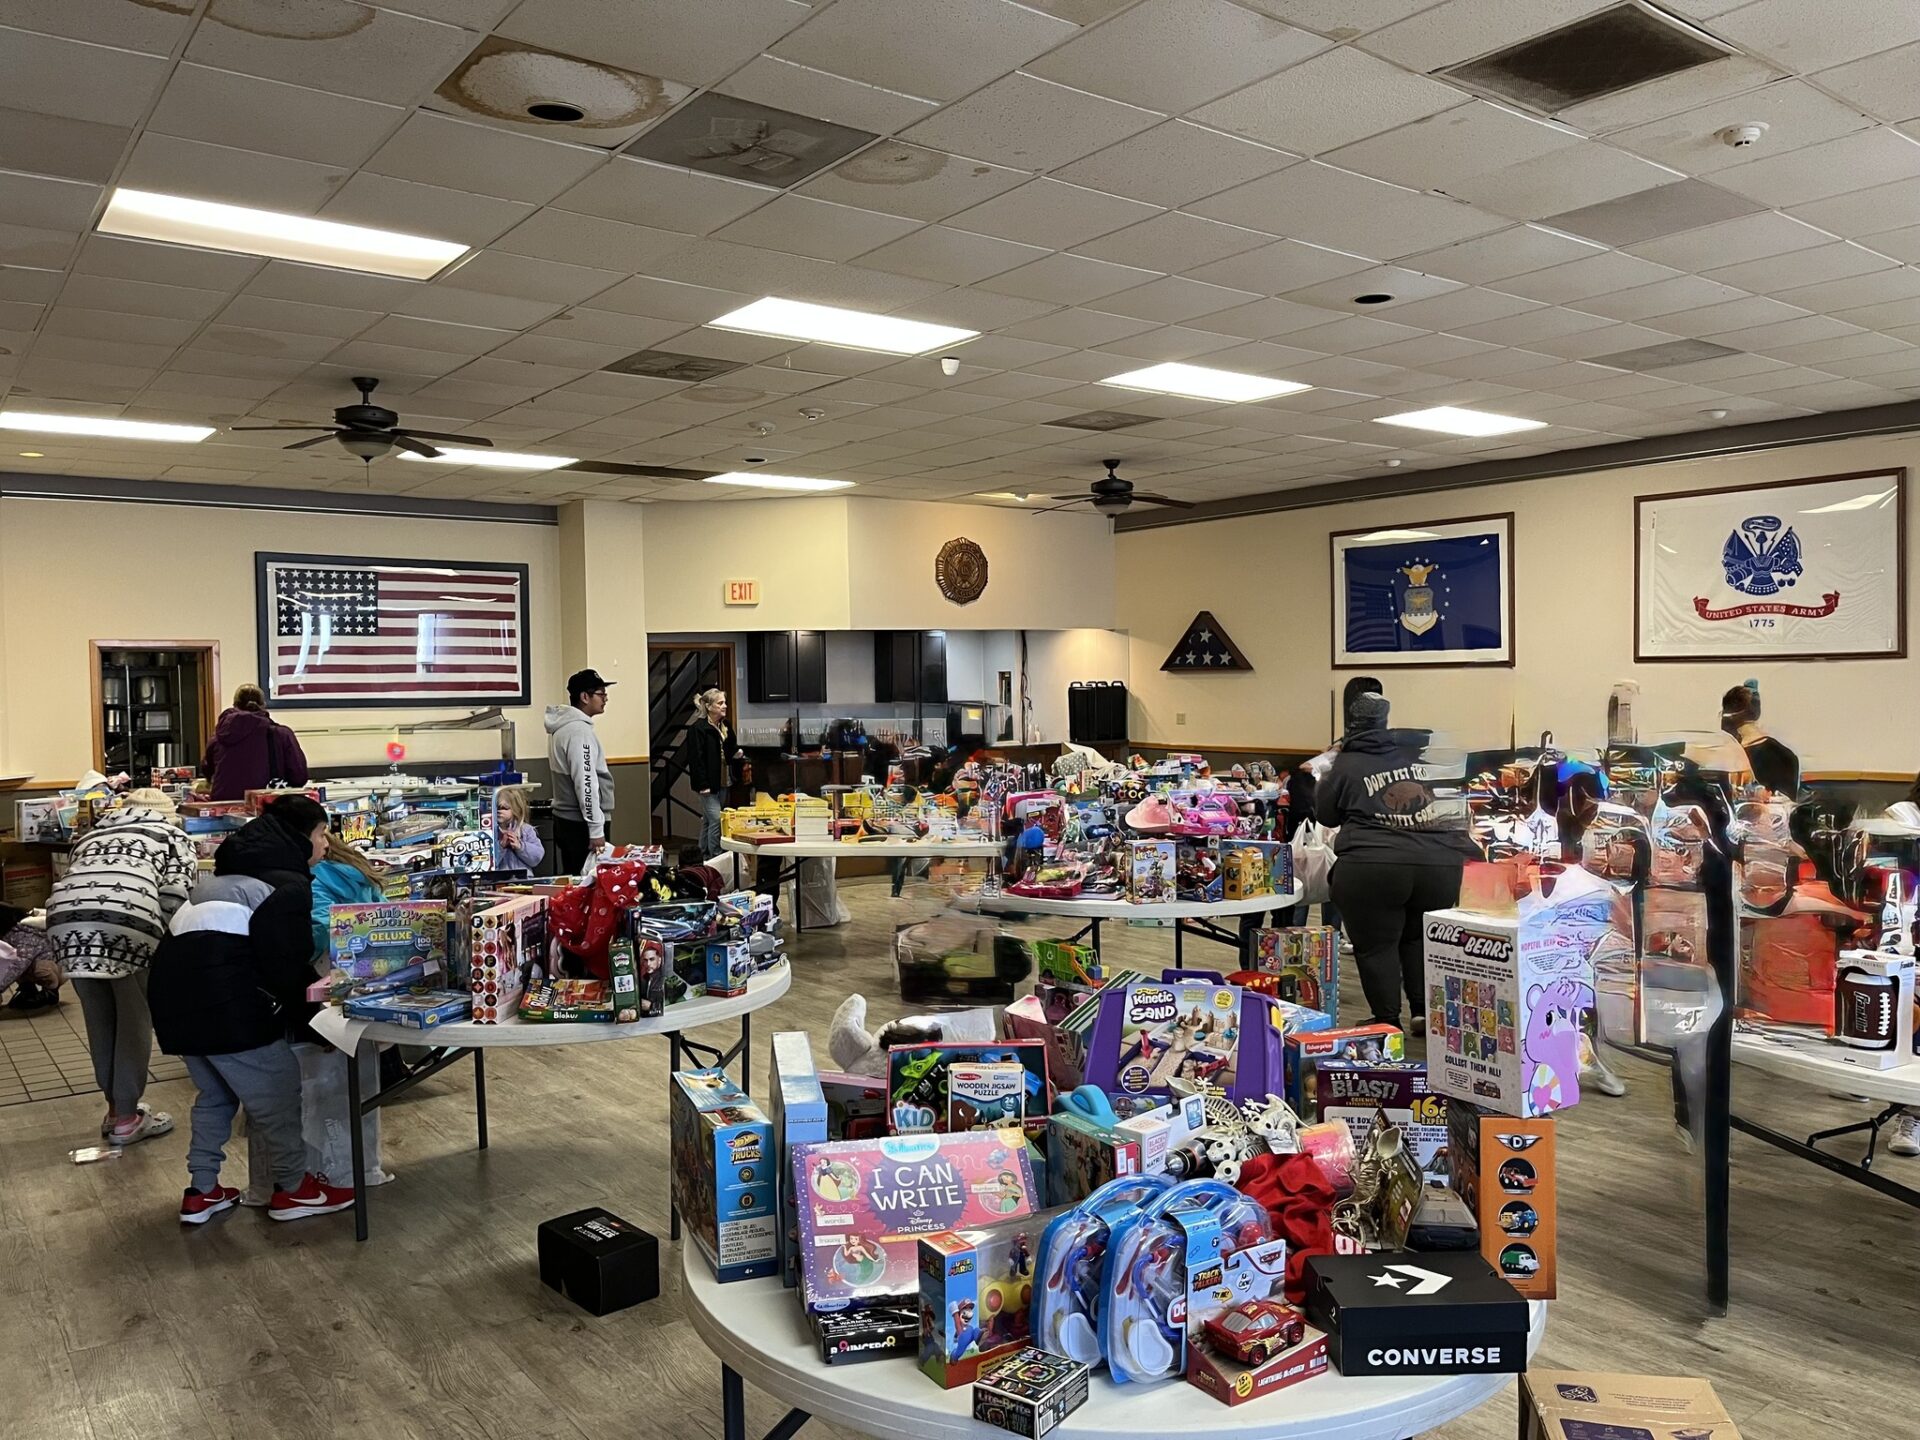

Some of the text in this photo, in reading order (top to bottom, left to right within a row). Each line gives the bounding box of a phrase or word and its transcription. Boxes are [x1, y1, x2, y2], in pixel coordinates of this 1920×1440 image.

[731, 582, 753, 601] EXIT
[1705, 605, 1826, 620] UNITED STATES ARMY
[1749, 618, 1776, 629] 1775
[582, 743, 594, 822] AMERICAN EAGLE
[1363, 771, 1393, 798] DON'T
[371, 931, 413, 941] DELUXE
[1427, 922, 1513, 963] CARE BEARS
[1132, 991, 1174, 1005] Kinetic
[553, 1011, 579, 1019] Blokus
[1853, 991, 1871, 1033] Franklin
[1444, 1054, 1502, 1079] COLLECT THEM ALL!
[1329, 1072, 1360, 1081] IT'S A
[956, 1081, 1016, 1091] WOODEN JIGSAW
[973, 1089, 999, 1097] PUZZLE
[1331, 1080, 1401, 1100] BLAST!
[1409, 1096, 1439, 1122] 16
[894, 1108, 935, 1128] KID
[1357, 1116, 1371, 1125] BOX
[1512, 1137, 1523, 1147] D
[732, 1151, 761, 1161] TRUCKS
[873, 1162, 954, 1189] I CAN
[871, 1184, 963, 1212] WRITE
[897, 1223, 946, 1234] PRINCESS
[948, 1263, 975, 1276] MARIO
[1196, 1269, 1220, 1281] TRACK
[1368, 1347, 1501, 1366] CONVERSE
[978, 1390, 1032, 1414] Lite-Brite
